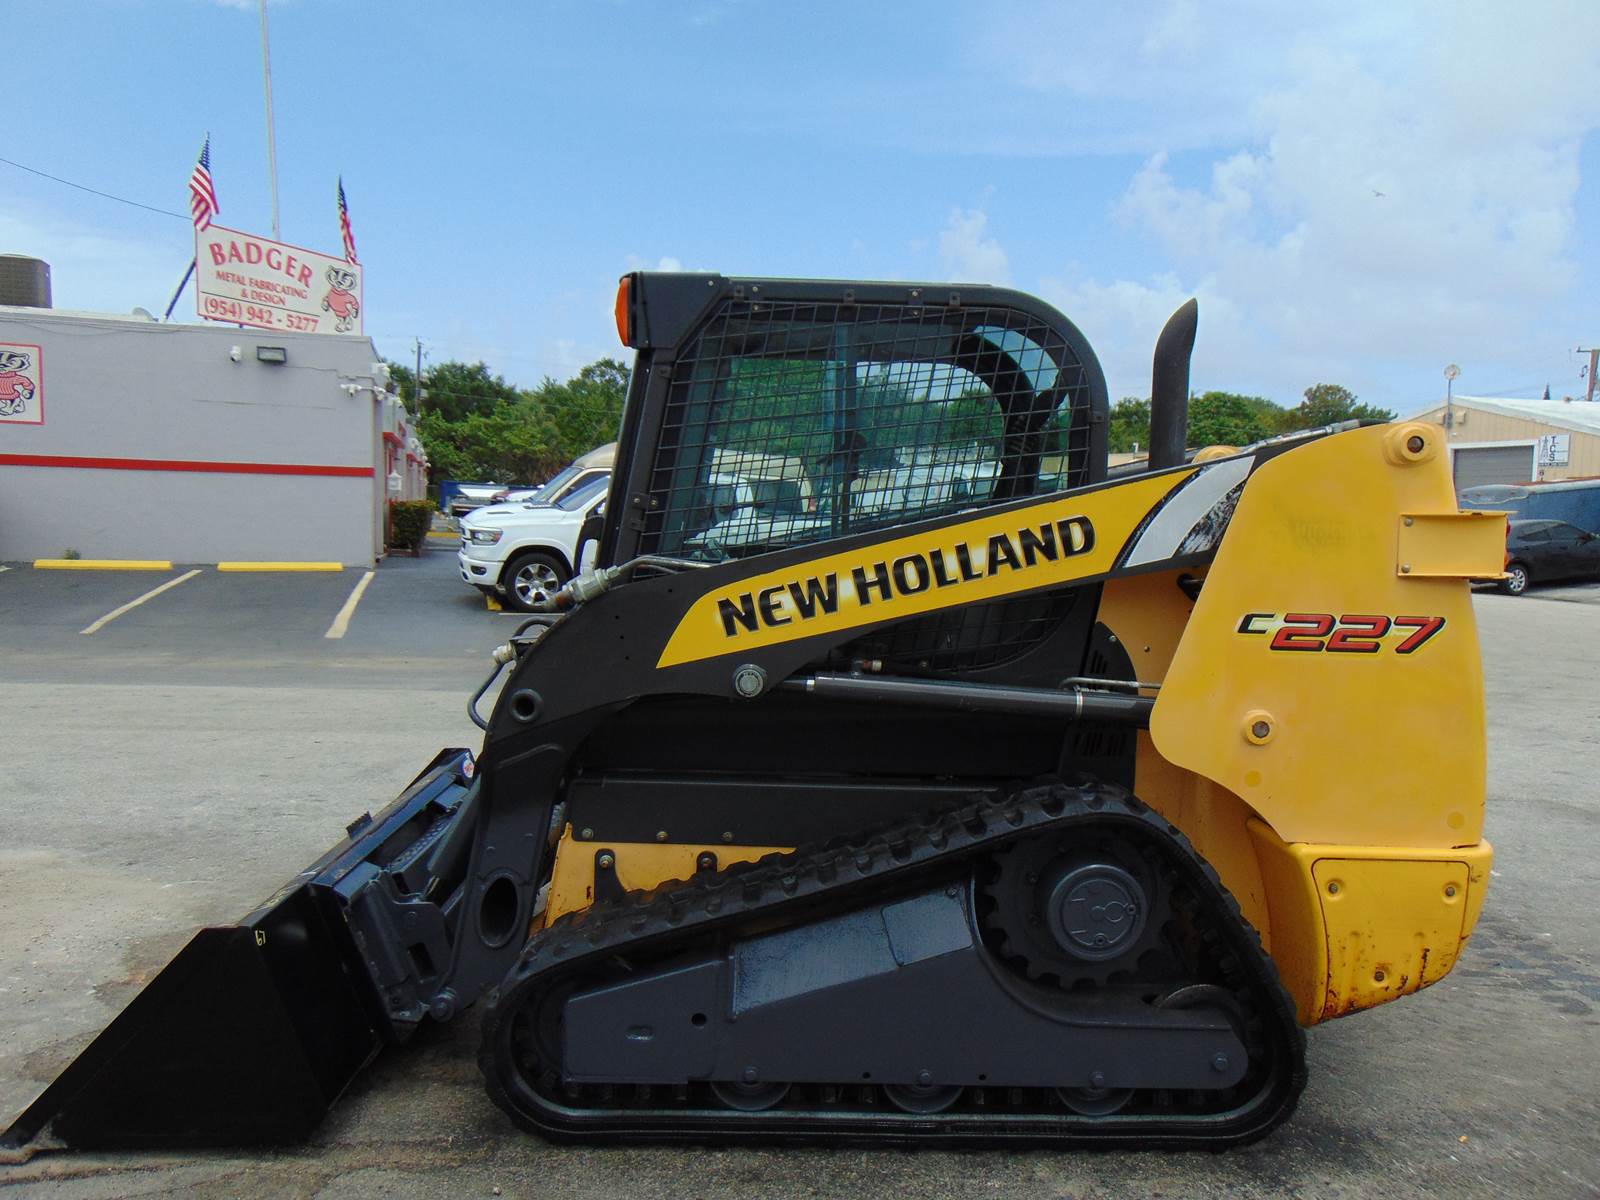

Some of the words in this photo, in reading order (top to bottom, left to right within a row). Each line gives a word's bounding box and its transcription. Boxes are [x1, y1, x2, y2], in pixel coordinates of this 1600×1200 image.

[209, 241, 313, 288] BADGER
[216, 270, 246, 286] METAL
[248, 278, 308, 299] FABRICATING
[241, 289, 248, 299] &
[250, 291, 286, 305] DESIGN
[204, 297, 243, 318] (954)
[247, 305, 273, 324] 942
[286, 314, 319, 332] 5277
[716, 572, 839, 638] NEW
[852, 514, 1097, 606] HOLLAND
